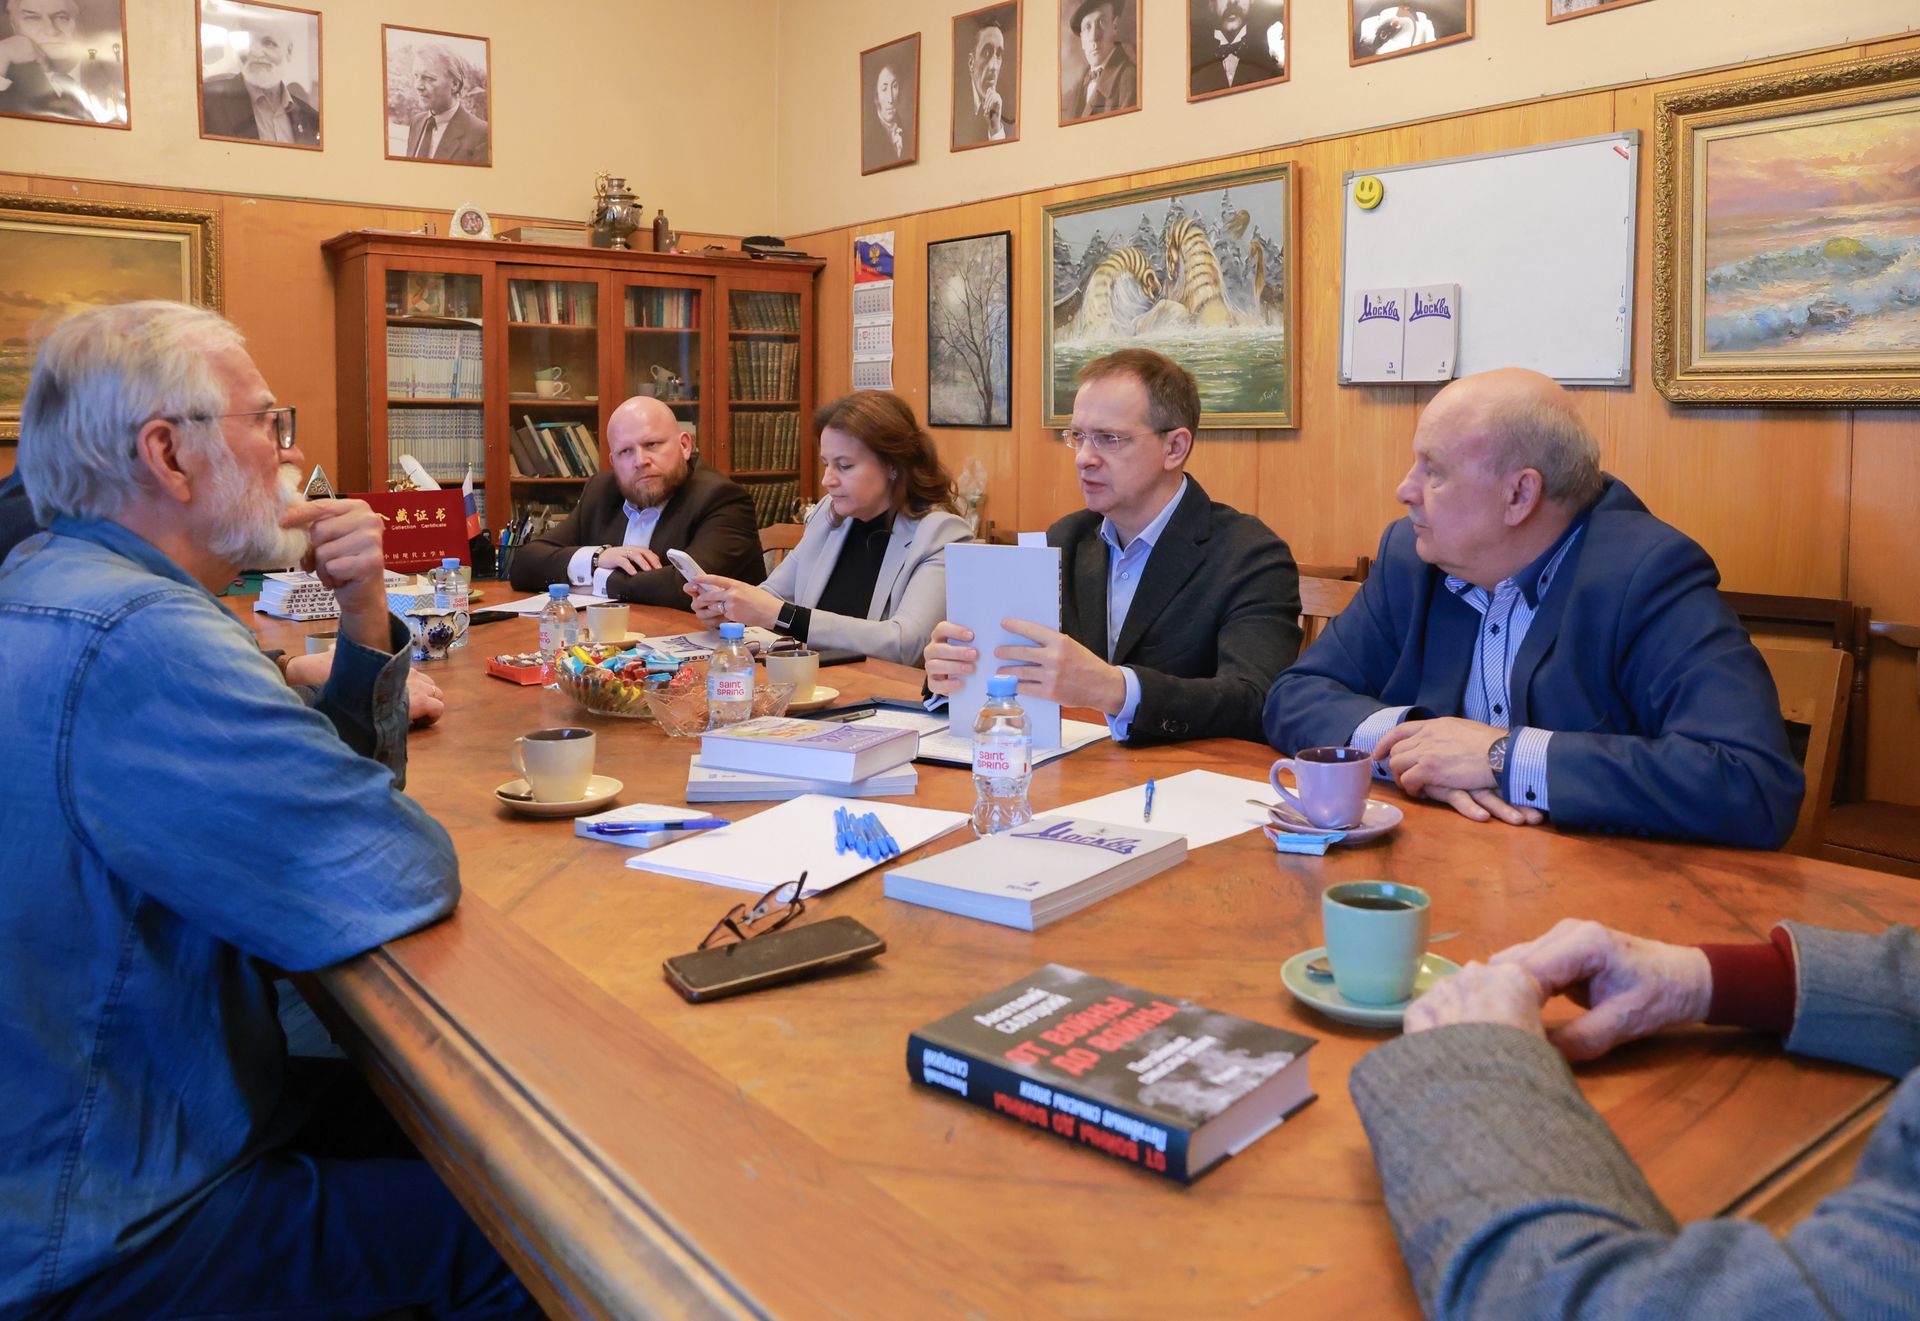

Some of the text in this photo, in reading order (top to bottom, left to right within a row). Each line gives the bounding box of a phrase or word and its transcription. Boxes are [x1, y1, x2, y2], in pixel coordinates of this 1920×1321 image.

[1358, 294, 1400, 323] Москва
[1409, 292, 1451, 322] Москва
[977, 759, 1010, 770] SPRING
[1010, 820, 1142, 855] Москва
[1004, 995, 1135, 1065] ОТ ВОЙНЫ
[1051, 1047, 1101, 1076] ДО
[1086, 999, 1180, 1053] ВОЙНЫ
